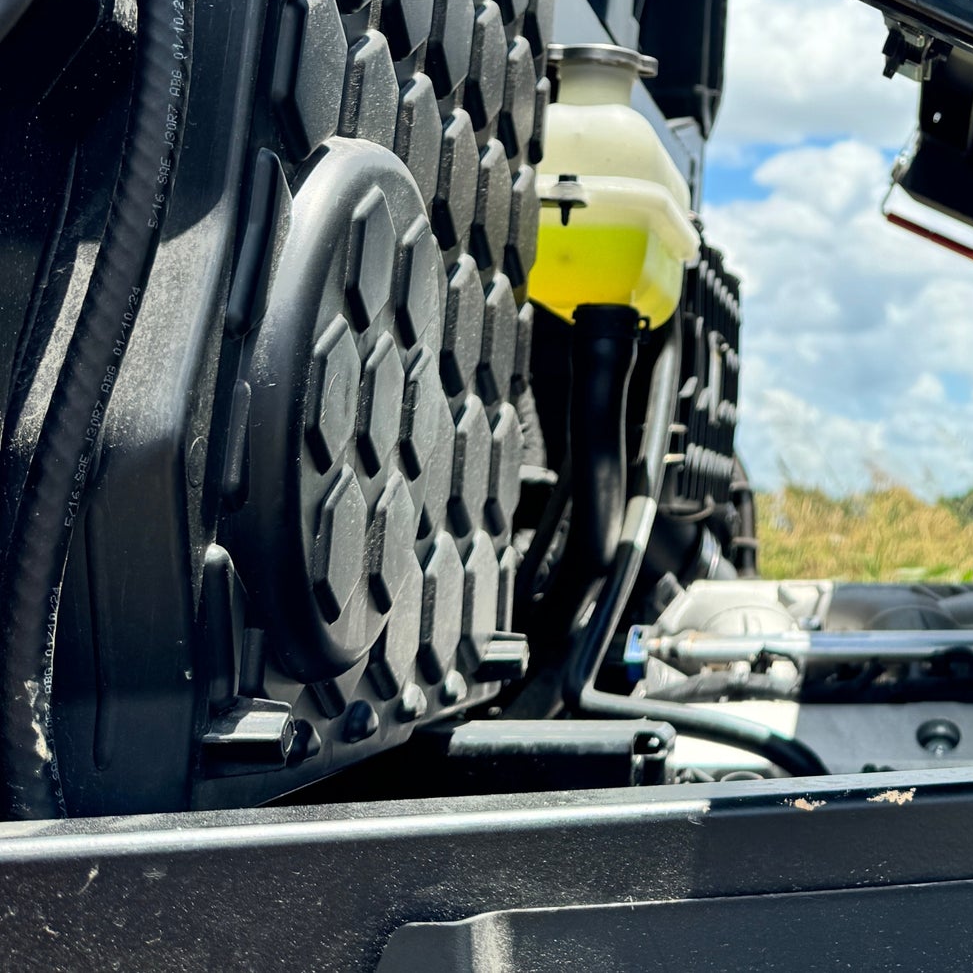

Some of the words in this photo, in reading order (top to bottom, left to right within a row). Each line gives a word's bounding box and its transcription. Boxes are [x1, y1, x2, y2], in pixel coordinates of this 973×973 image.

[163, 103, 179, 149] J30R7
[157, 156, 172, 185] SAE
[148, 192, 165, 229] 5/16
[64, 490, 81, 528] 5/16
[74, 453, 90, 484] SAE
[112, 286, 141, 356] 01/10/24
